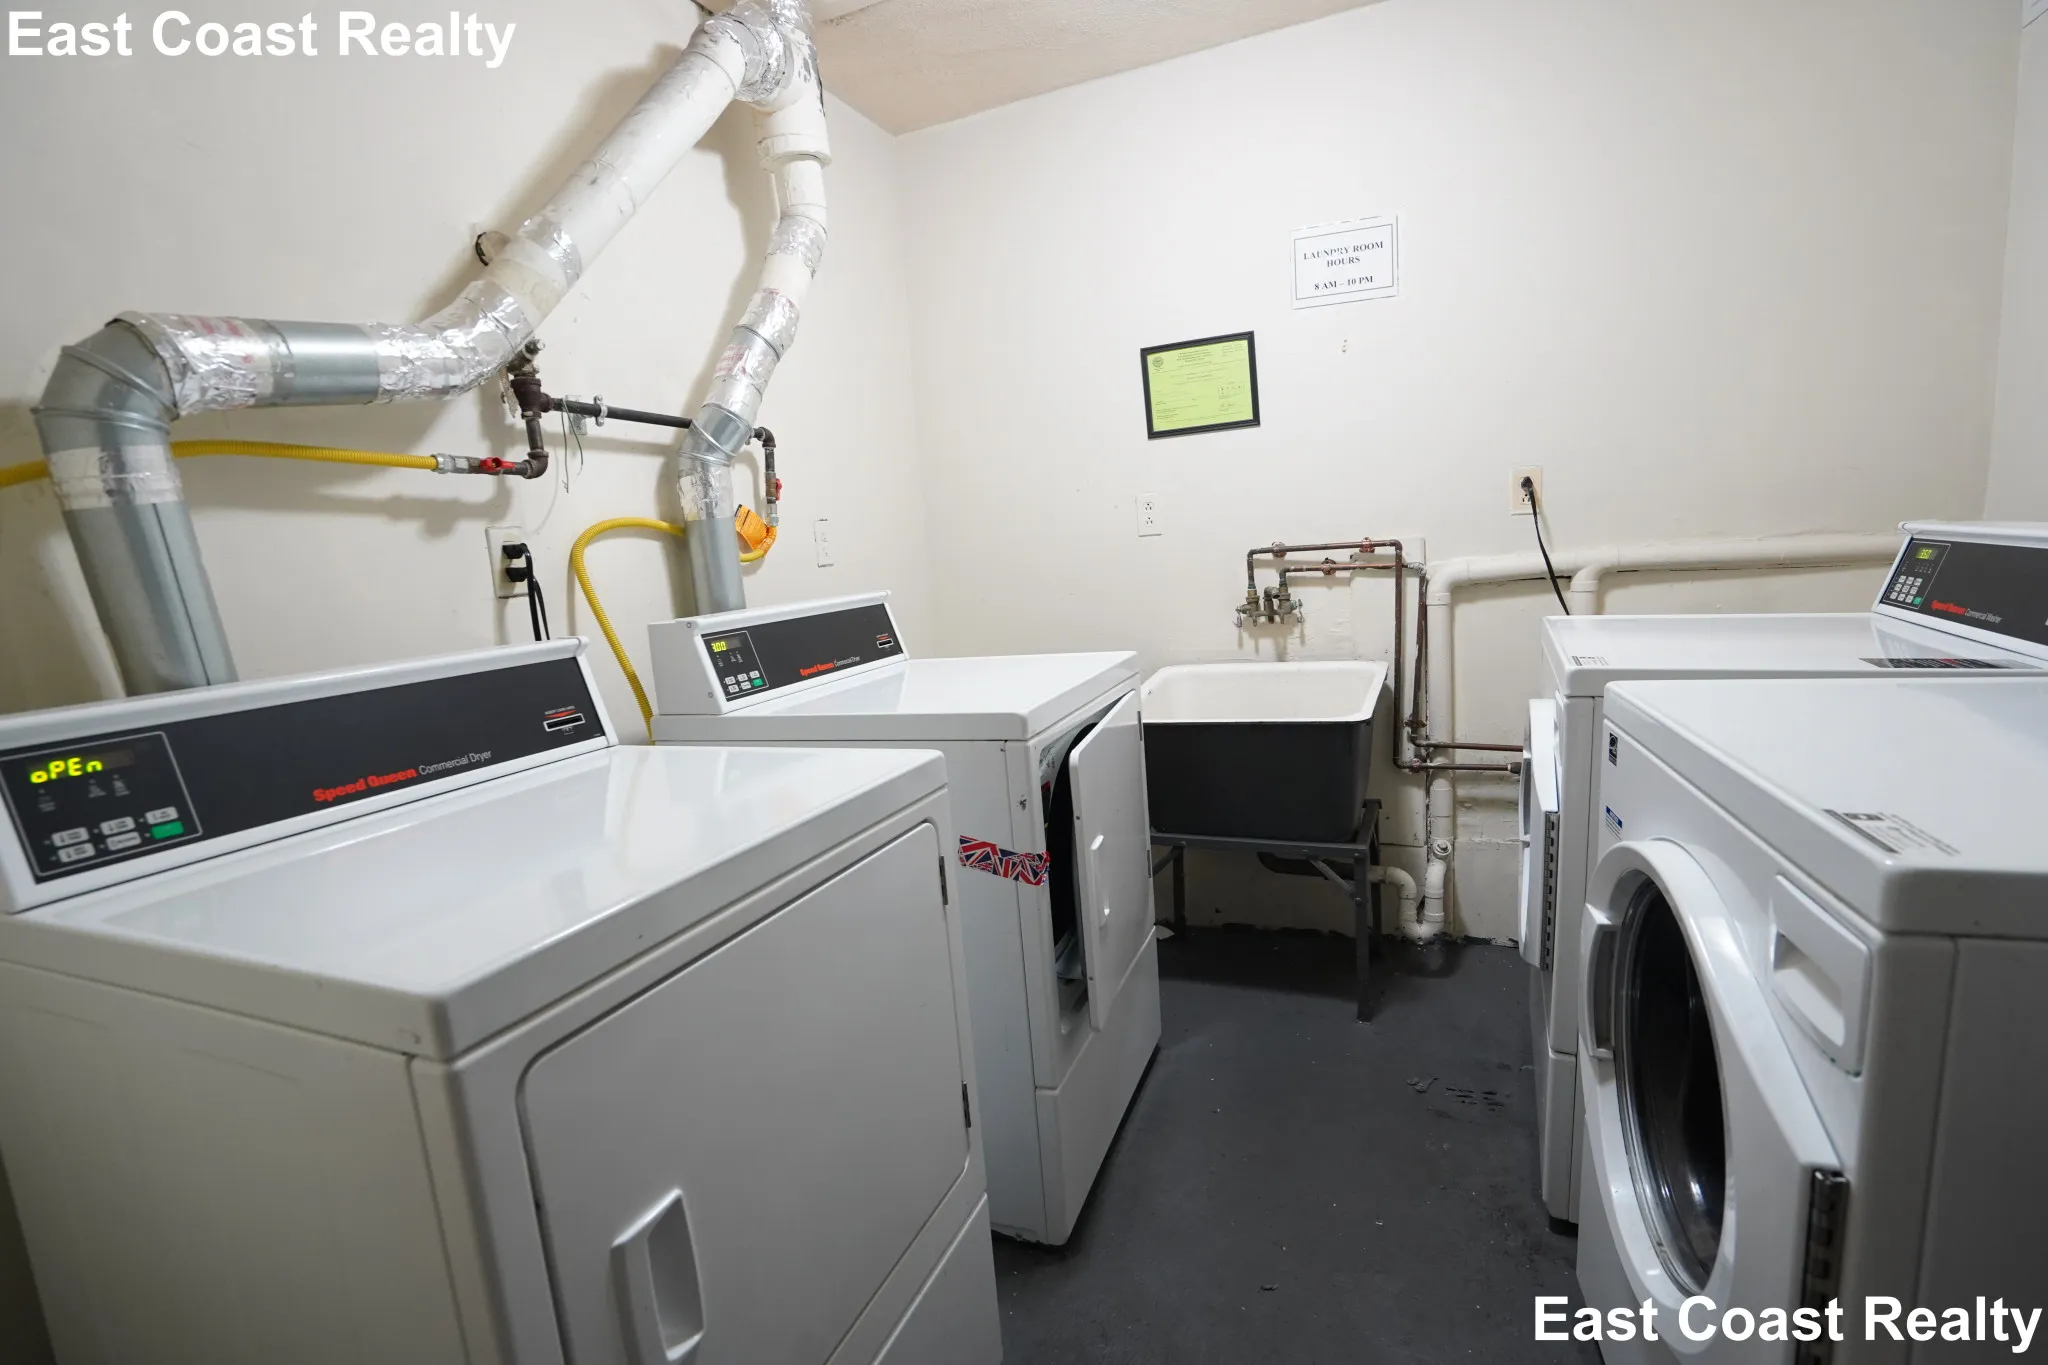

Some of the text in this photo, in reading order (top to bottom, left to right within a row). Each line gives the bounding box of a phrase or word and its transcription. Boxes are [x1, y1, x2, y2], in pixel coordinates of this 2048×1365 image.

[1304, 241, 1384, 260] LAUNDRY ROOM
[1326, 255, 1361, 268] HOURS
[1314, 282, 1320, 291] 8
[1321, 280, 1338, 290] AM
[1347, 277, 1357, 286] 10
[1359, 275, 1374, 285] PM
[312, 750, 493, 802] Speed Queen Commercial Dryer
